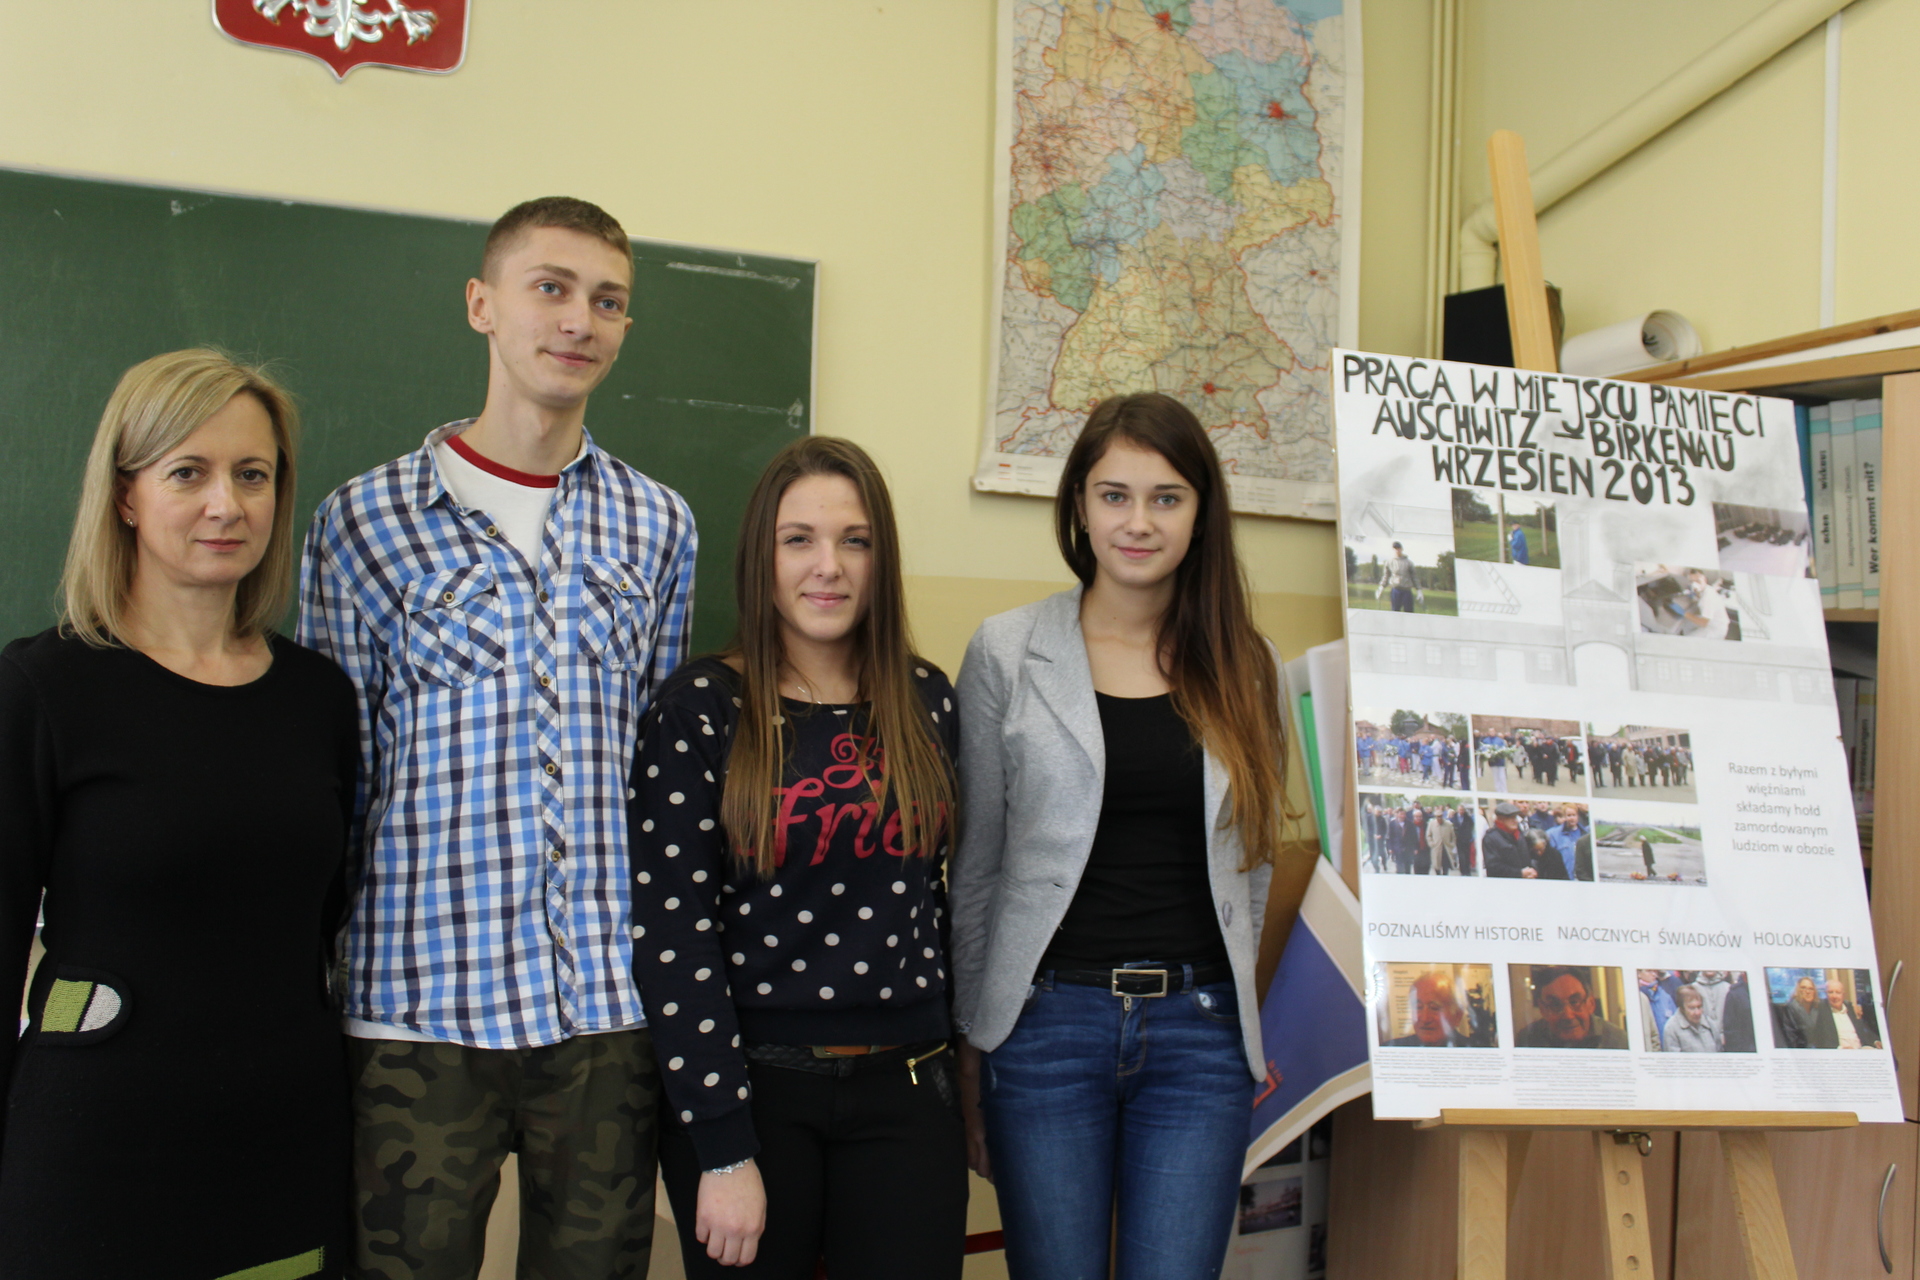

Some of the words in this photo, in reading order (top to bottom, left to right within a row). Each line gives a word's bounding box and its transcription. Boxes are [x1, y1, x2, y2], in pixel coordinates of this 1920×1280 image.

[1344, 354, 1457, 403] PRACA
[1470, 368, 1498, 405] W
[1601, 458, 1695, 506] 2013
[1863, 462, 1875, 492] mit?
[1867, 496, 1879, 544] kommt
[1728, 762, 1768, 775] Razem
[1771, 767, 1777, 776] z
[1779, 765, 1818, 780] byłymi
[1736, 801, 1791, 817] składamy
[1794, 804, 1821, 816] hołd
[1734, 822, 1828, 838] zamordowanym
[1732, 839, 1780, 853] ludziom
[1783, 844, 1793, 853] w
[1796, 843, 1835, 856] obozie
[1368, 921, 1470, 940] POZNALIŚMY
[1475, 926, 1544, 942] HISTORIE
[1557, 926, 1650, 944] NAOCZNYCH
[1658, 928, 1742, 948] ŚWIADKÓW
[1753, 931, 1851, 950] HOLOKAUSTU
